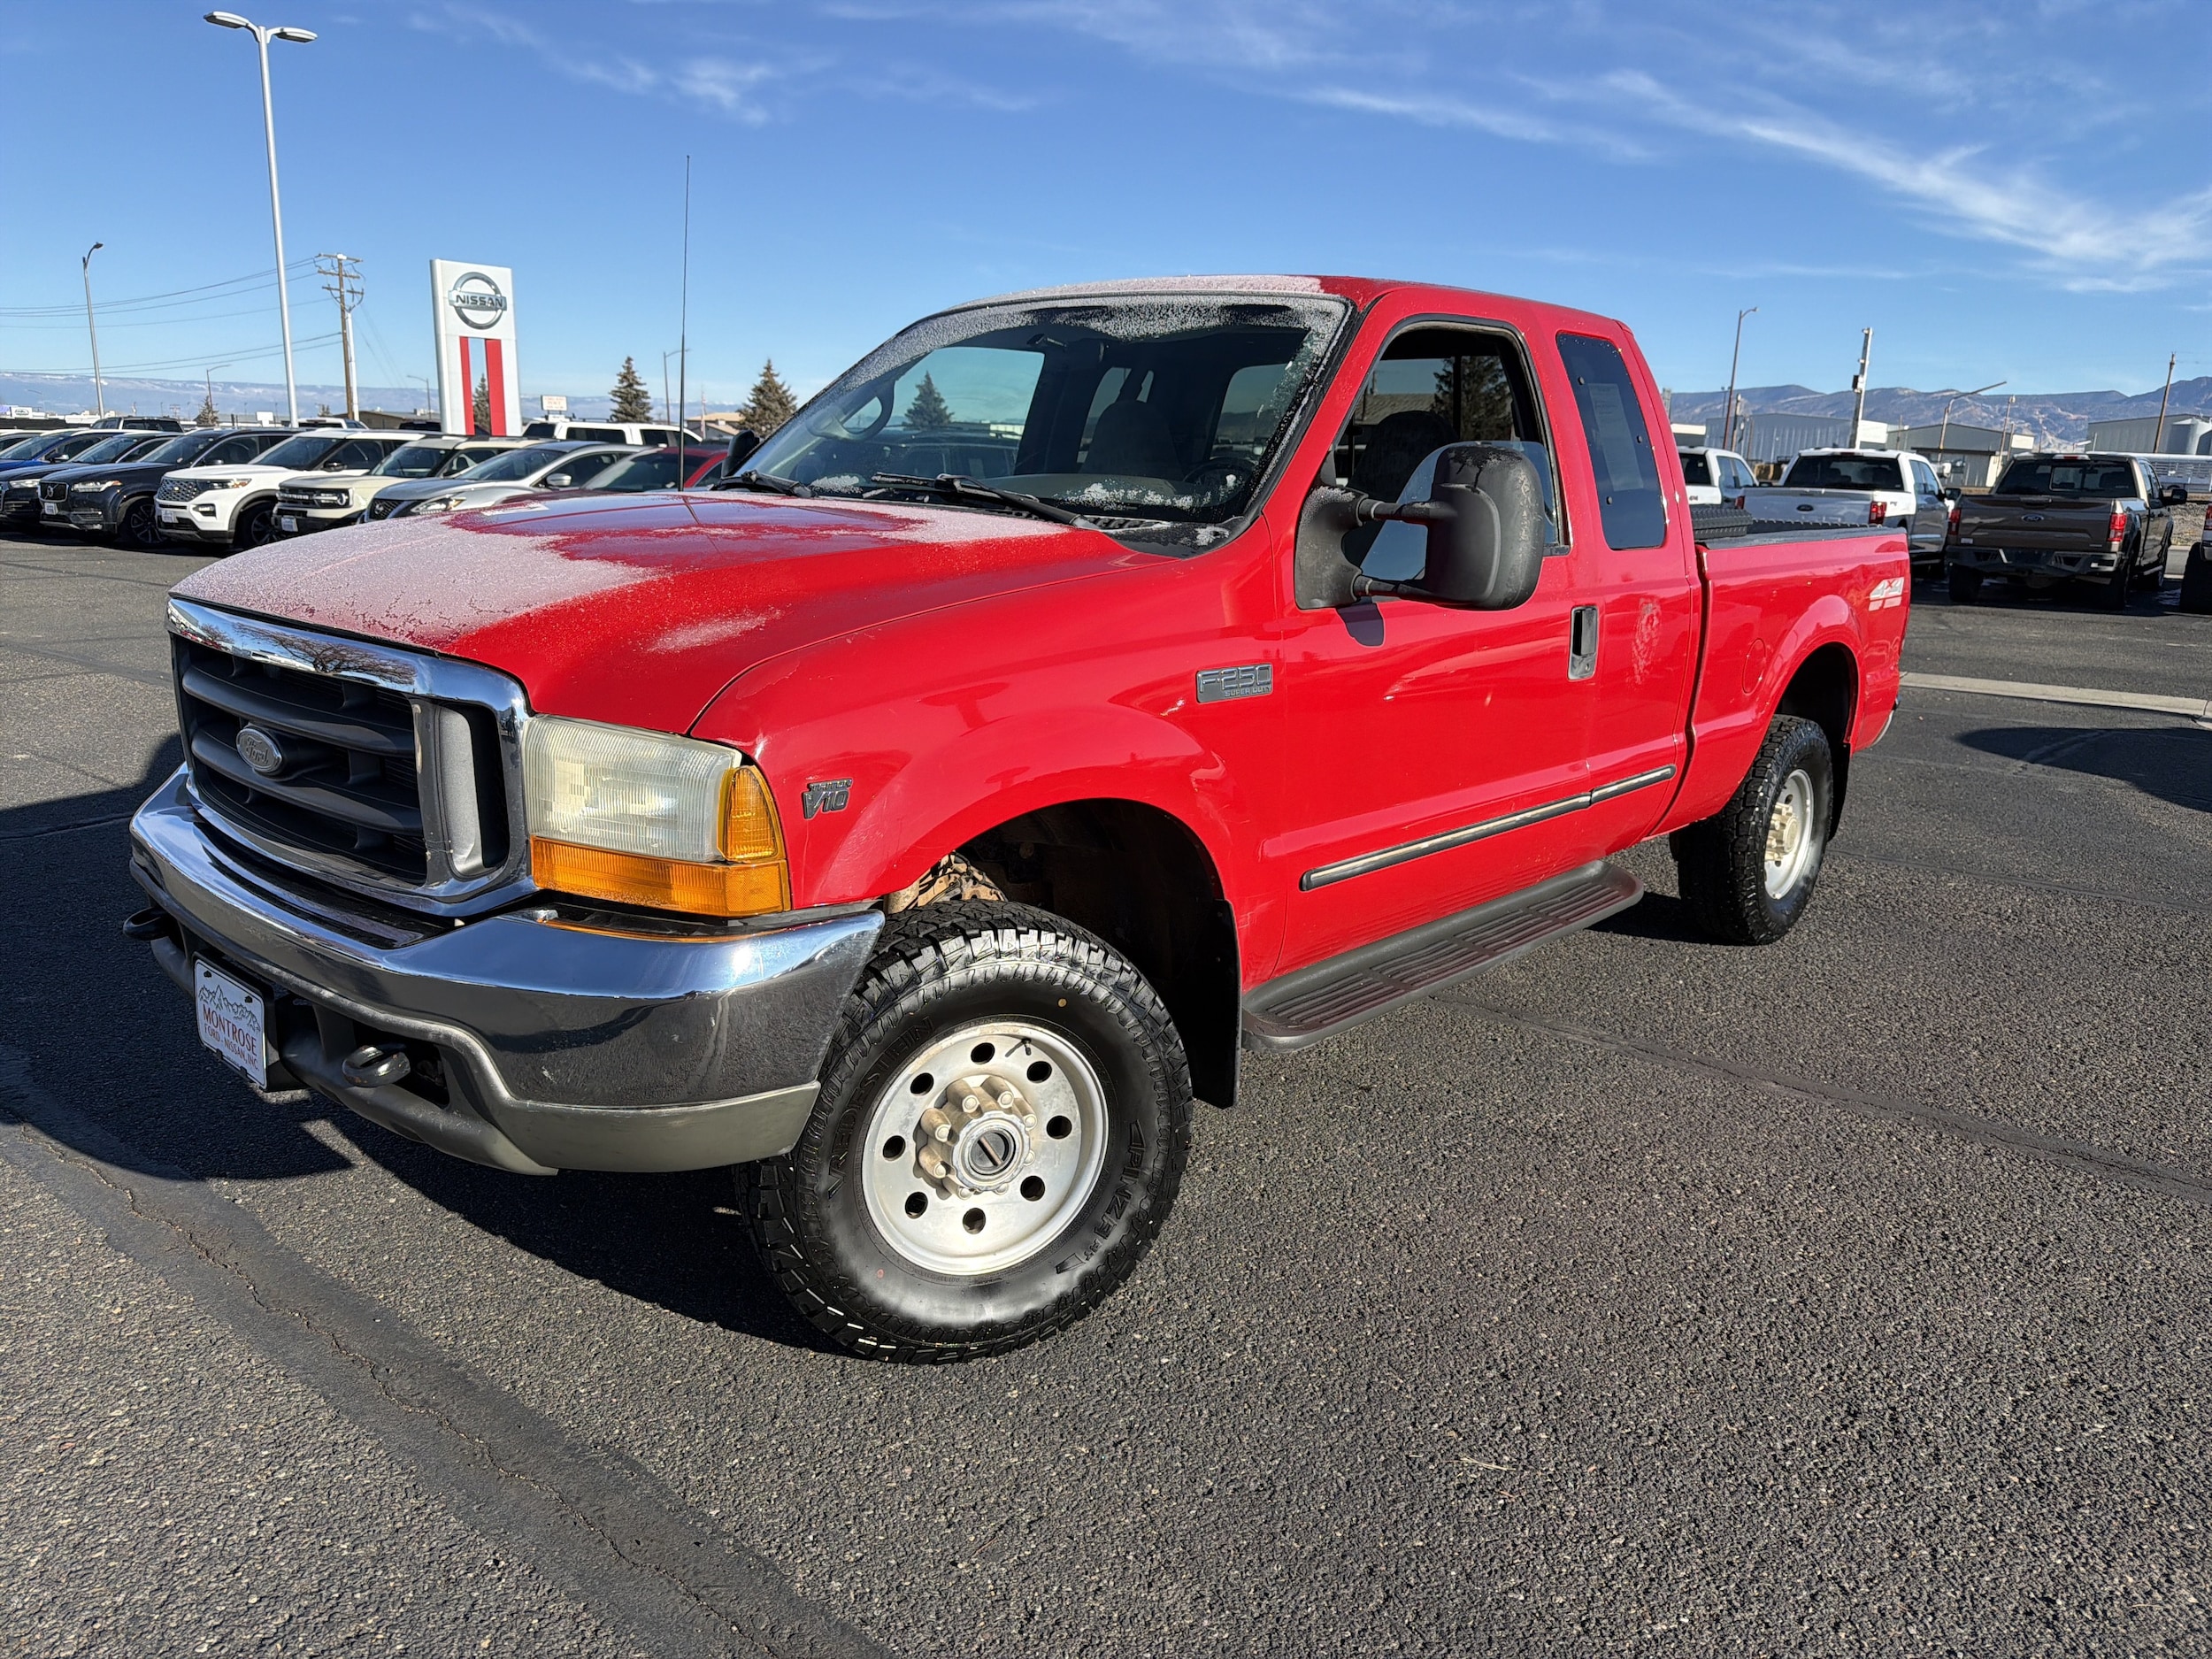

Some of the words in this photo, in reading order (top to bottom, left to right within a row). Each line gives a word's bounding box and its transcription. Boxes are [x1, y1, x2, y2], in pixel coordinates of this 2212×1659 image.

[455, 293, 503, 309] NISSAN
[1224, 687, 1250, 698] SUPER
[1252, 685, 1271, 695] DUTY
[245, 735, 269, 764] Ford
[802, 789, 849, 819] V10
[203, 1003, 257, 1056] MONTROSE
[204, 1024, 220, 1042] FORD
[827, 1015, 934, 1200] VREDESTEIN
